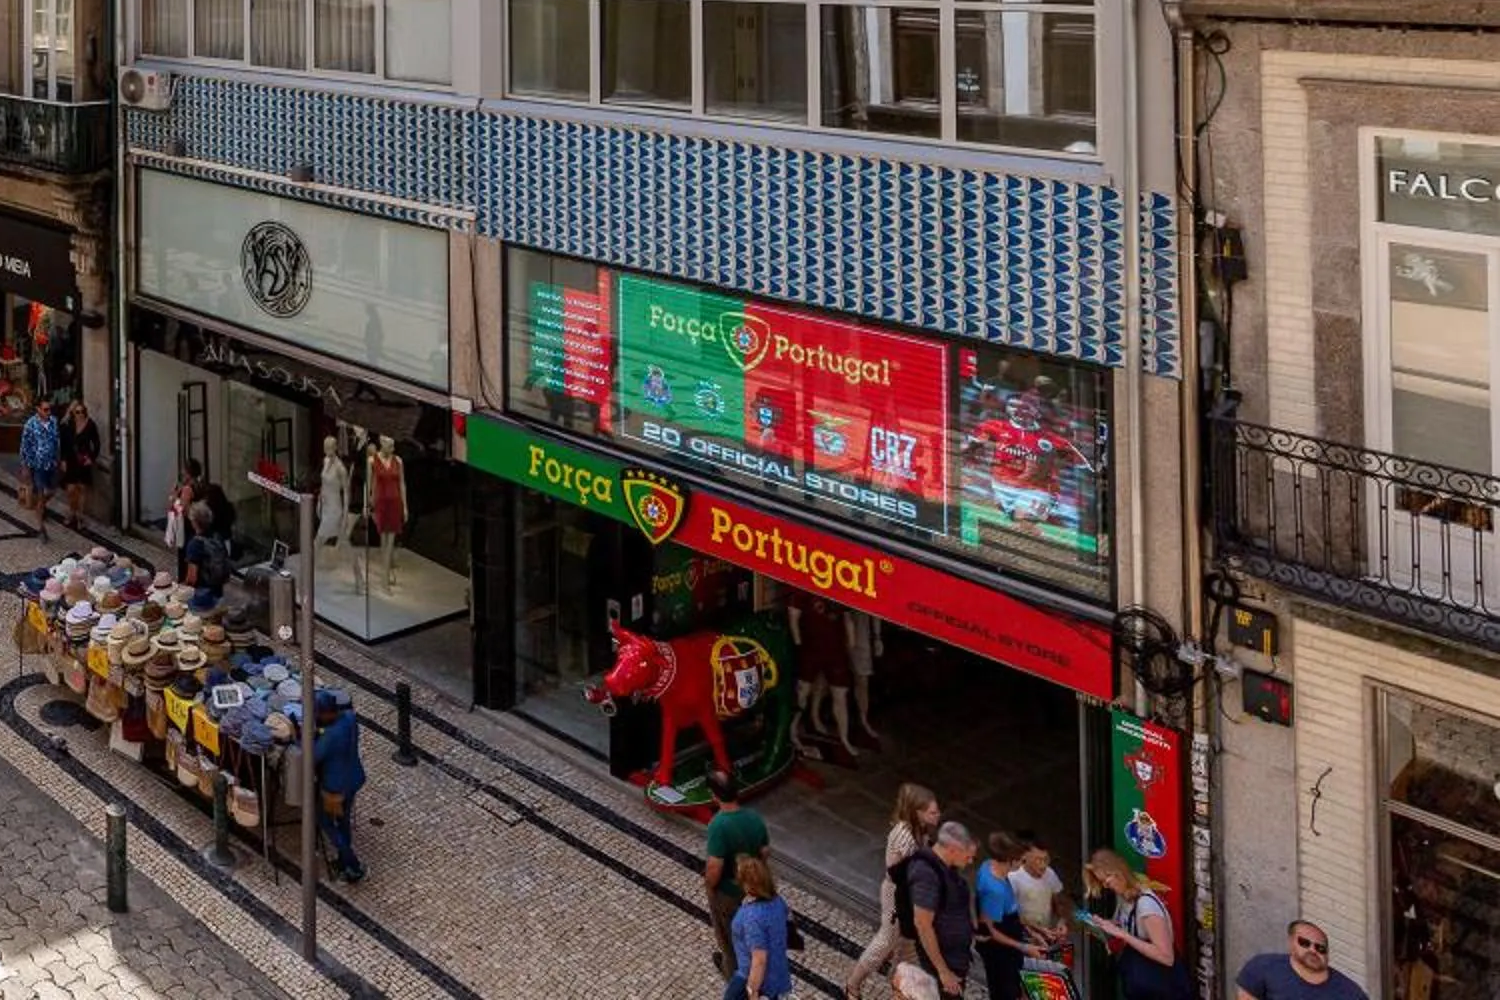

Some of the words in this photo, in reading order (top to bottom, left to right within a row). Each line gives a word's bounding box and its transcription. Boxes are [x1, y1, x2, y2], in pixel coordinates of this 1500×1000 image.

[1389, 170, 1500, 203] FALC
[650, 305, 717, 345] Força
[773, 334, 891, 386] Portugal
[529, 445, 613, 505] Força
[643, 421, 681, 449] 20
[689, 439, 799, 484] OFFICIAL
[805, 471, 917, 519] STORES
[870, 426, 917, 473] CR7
[997, 632, 1071, 668] STORE
